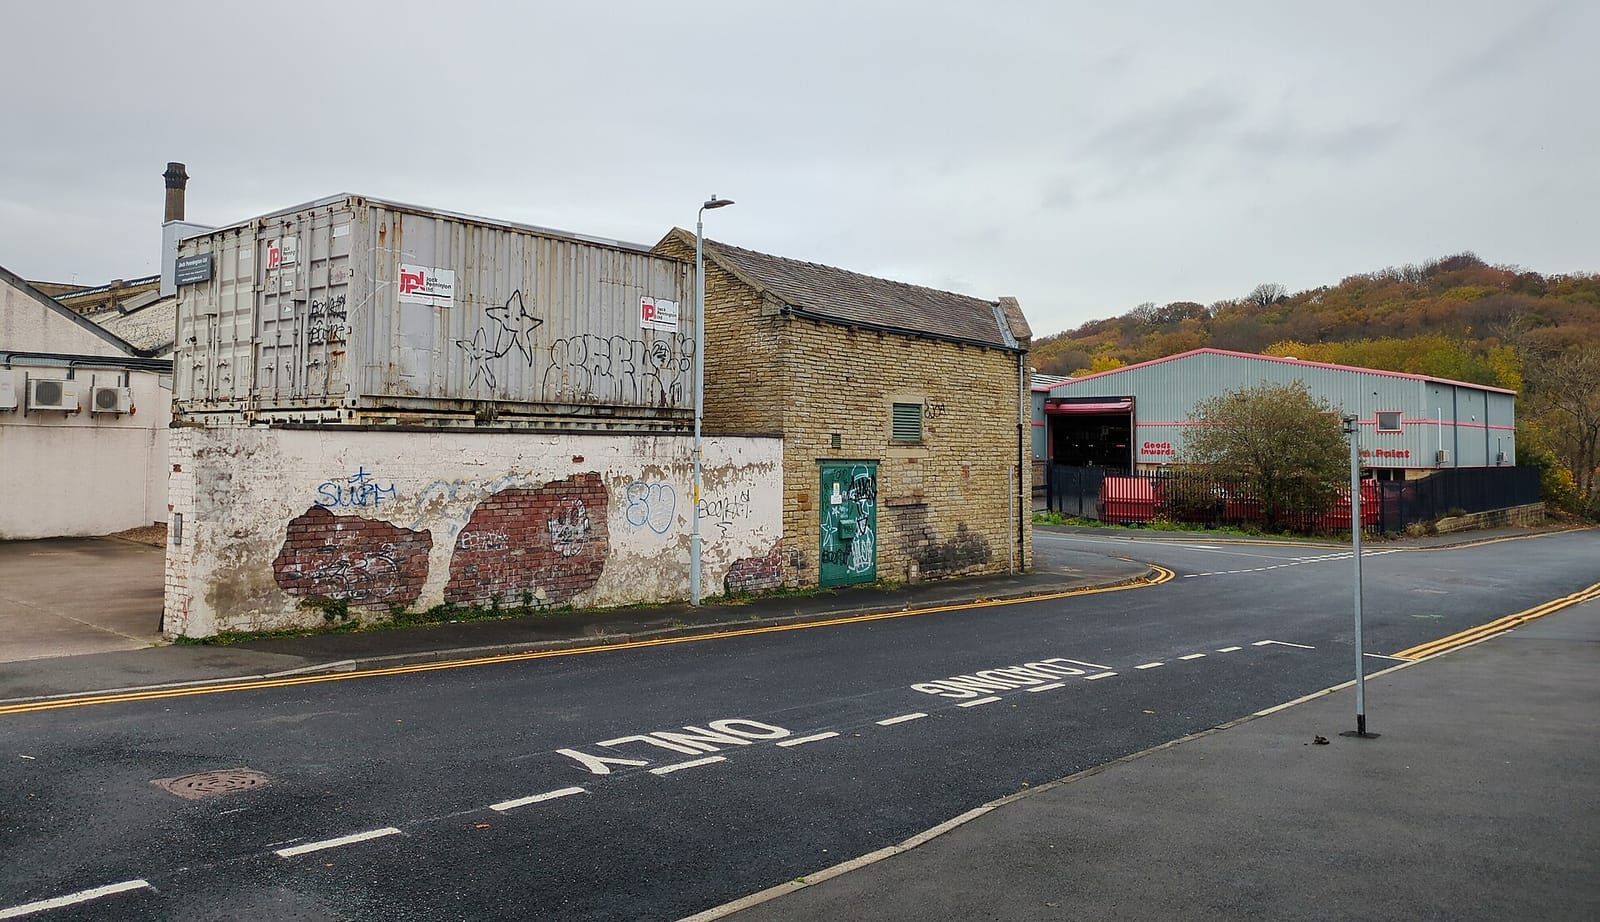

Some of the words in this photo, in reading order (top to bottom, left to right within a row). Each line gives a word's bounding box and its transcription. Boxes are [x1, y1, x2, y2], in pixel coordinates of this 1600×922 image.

[1144, 441, 1171, 449] Goods
[1141, 448, 1176, 456] Inwards
[1375, 449, 1410, 459] Point
[910, 658, 1113, 699] LOADING
[555, 719, 791, 775] ONLY
